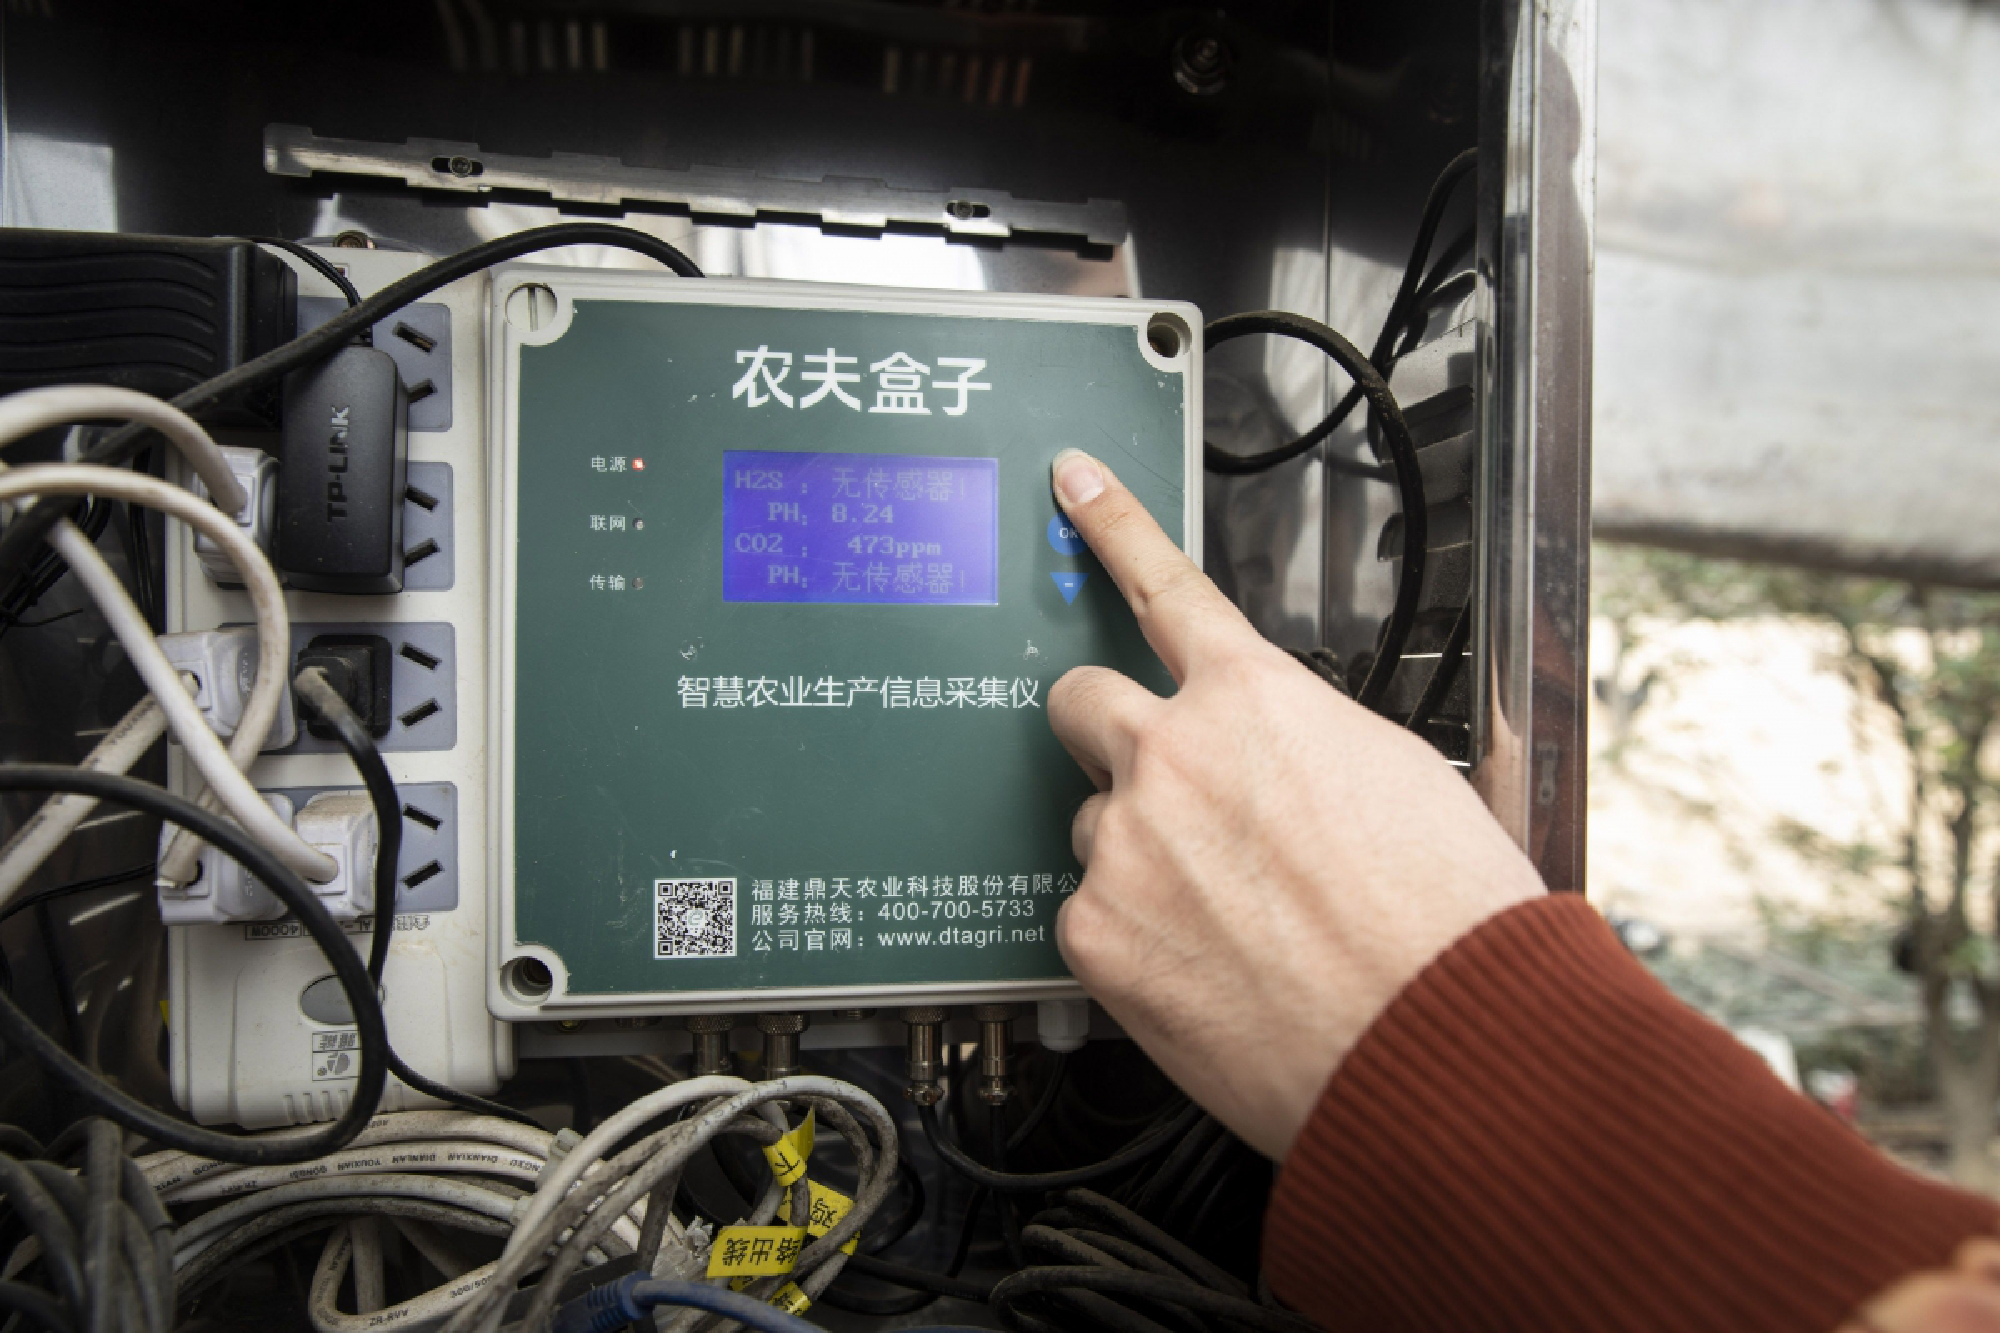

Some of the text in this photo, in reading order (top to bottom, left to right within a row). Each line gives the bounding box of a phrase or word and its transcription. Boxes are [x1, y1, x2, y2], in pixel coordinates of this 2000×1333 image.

[732, 345, 992, 416] 农夫盒子
[327, 404, 351, 523] TP-LINK
[590, 455, 627, 473] 电源
[590, 514, 626, 532] 联网
[832, 503, 893, 523] 8.24
[847, 535, 942, 559] 473ppm
[589, 573, 626, 591] 传输
[677, 675, 1041, 709] 智慧农业生产信息采集仪
[752, 873, 1078, 901] 福建鼎天农业科技股份有限公
[877, 899, 1034, 921] 400-700-5733
[877, 925, 1045, 949] www.dtagri.net
